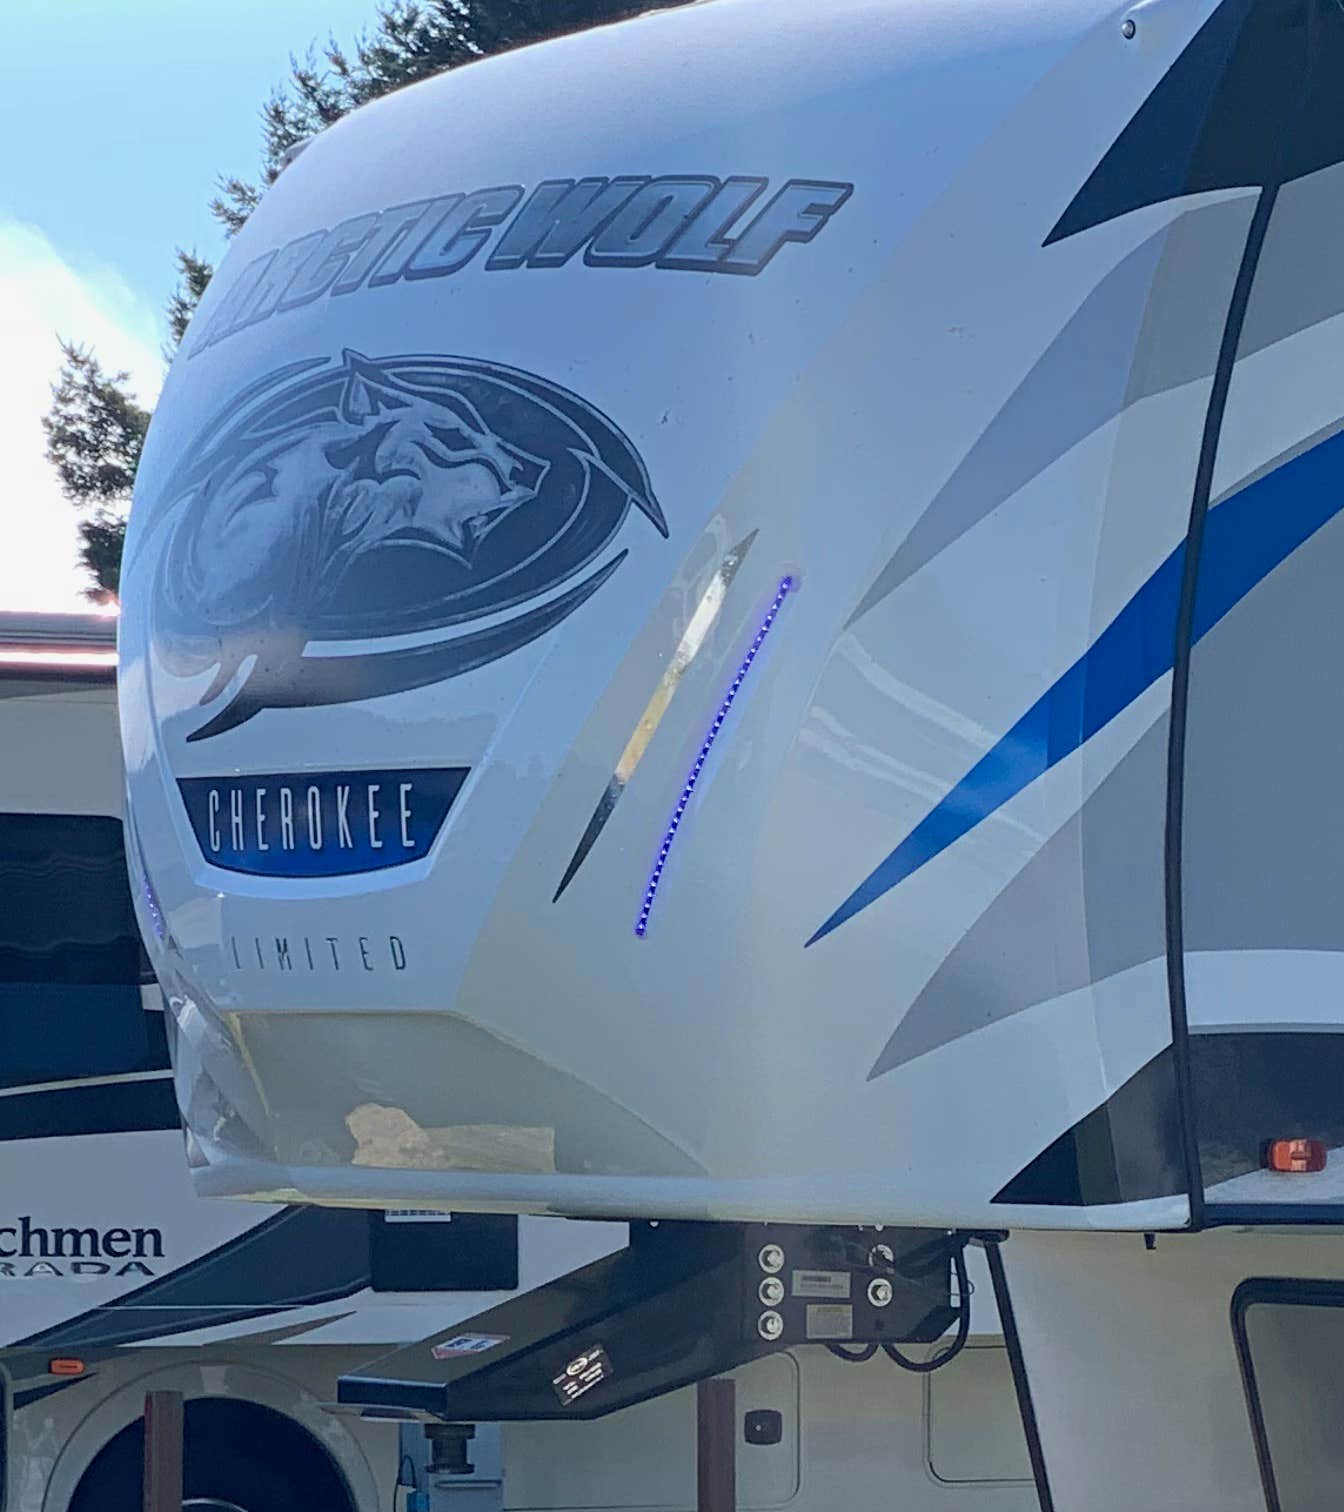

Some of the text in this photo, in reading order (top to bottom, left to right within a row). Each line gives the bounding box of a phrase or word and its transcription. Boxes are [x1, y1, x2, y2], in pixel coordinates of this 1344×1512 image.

[188, 174, 854, 360] ARCTIC WOLF
[208, 783, 416, 852] CHEROKEE
[231, 935, 408, 972] LIMITED
[0, 1216, 165, 1258] chmen
